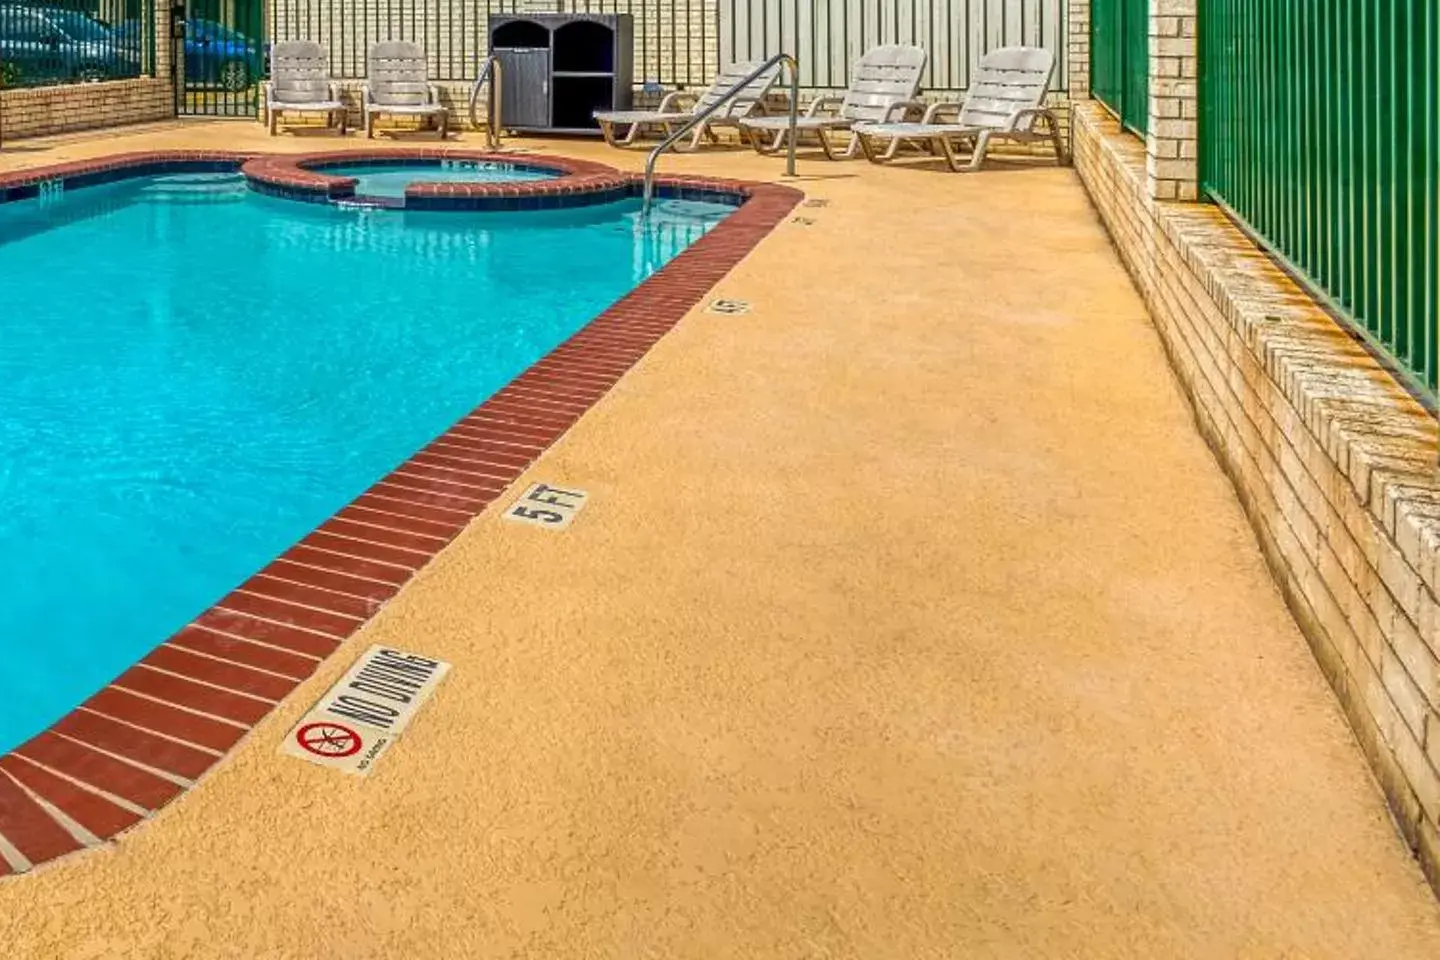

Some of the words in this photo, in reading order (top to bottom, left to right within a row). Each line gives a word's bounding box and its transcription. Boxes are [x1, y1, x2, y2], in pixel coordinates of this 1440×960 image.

[527, 483, 585, 508] FT
[512, 506, 563, 523] 5
[348, 649, 438, 703] DIVING
[327, 695, 400, 729] NO
